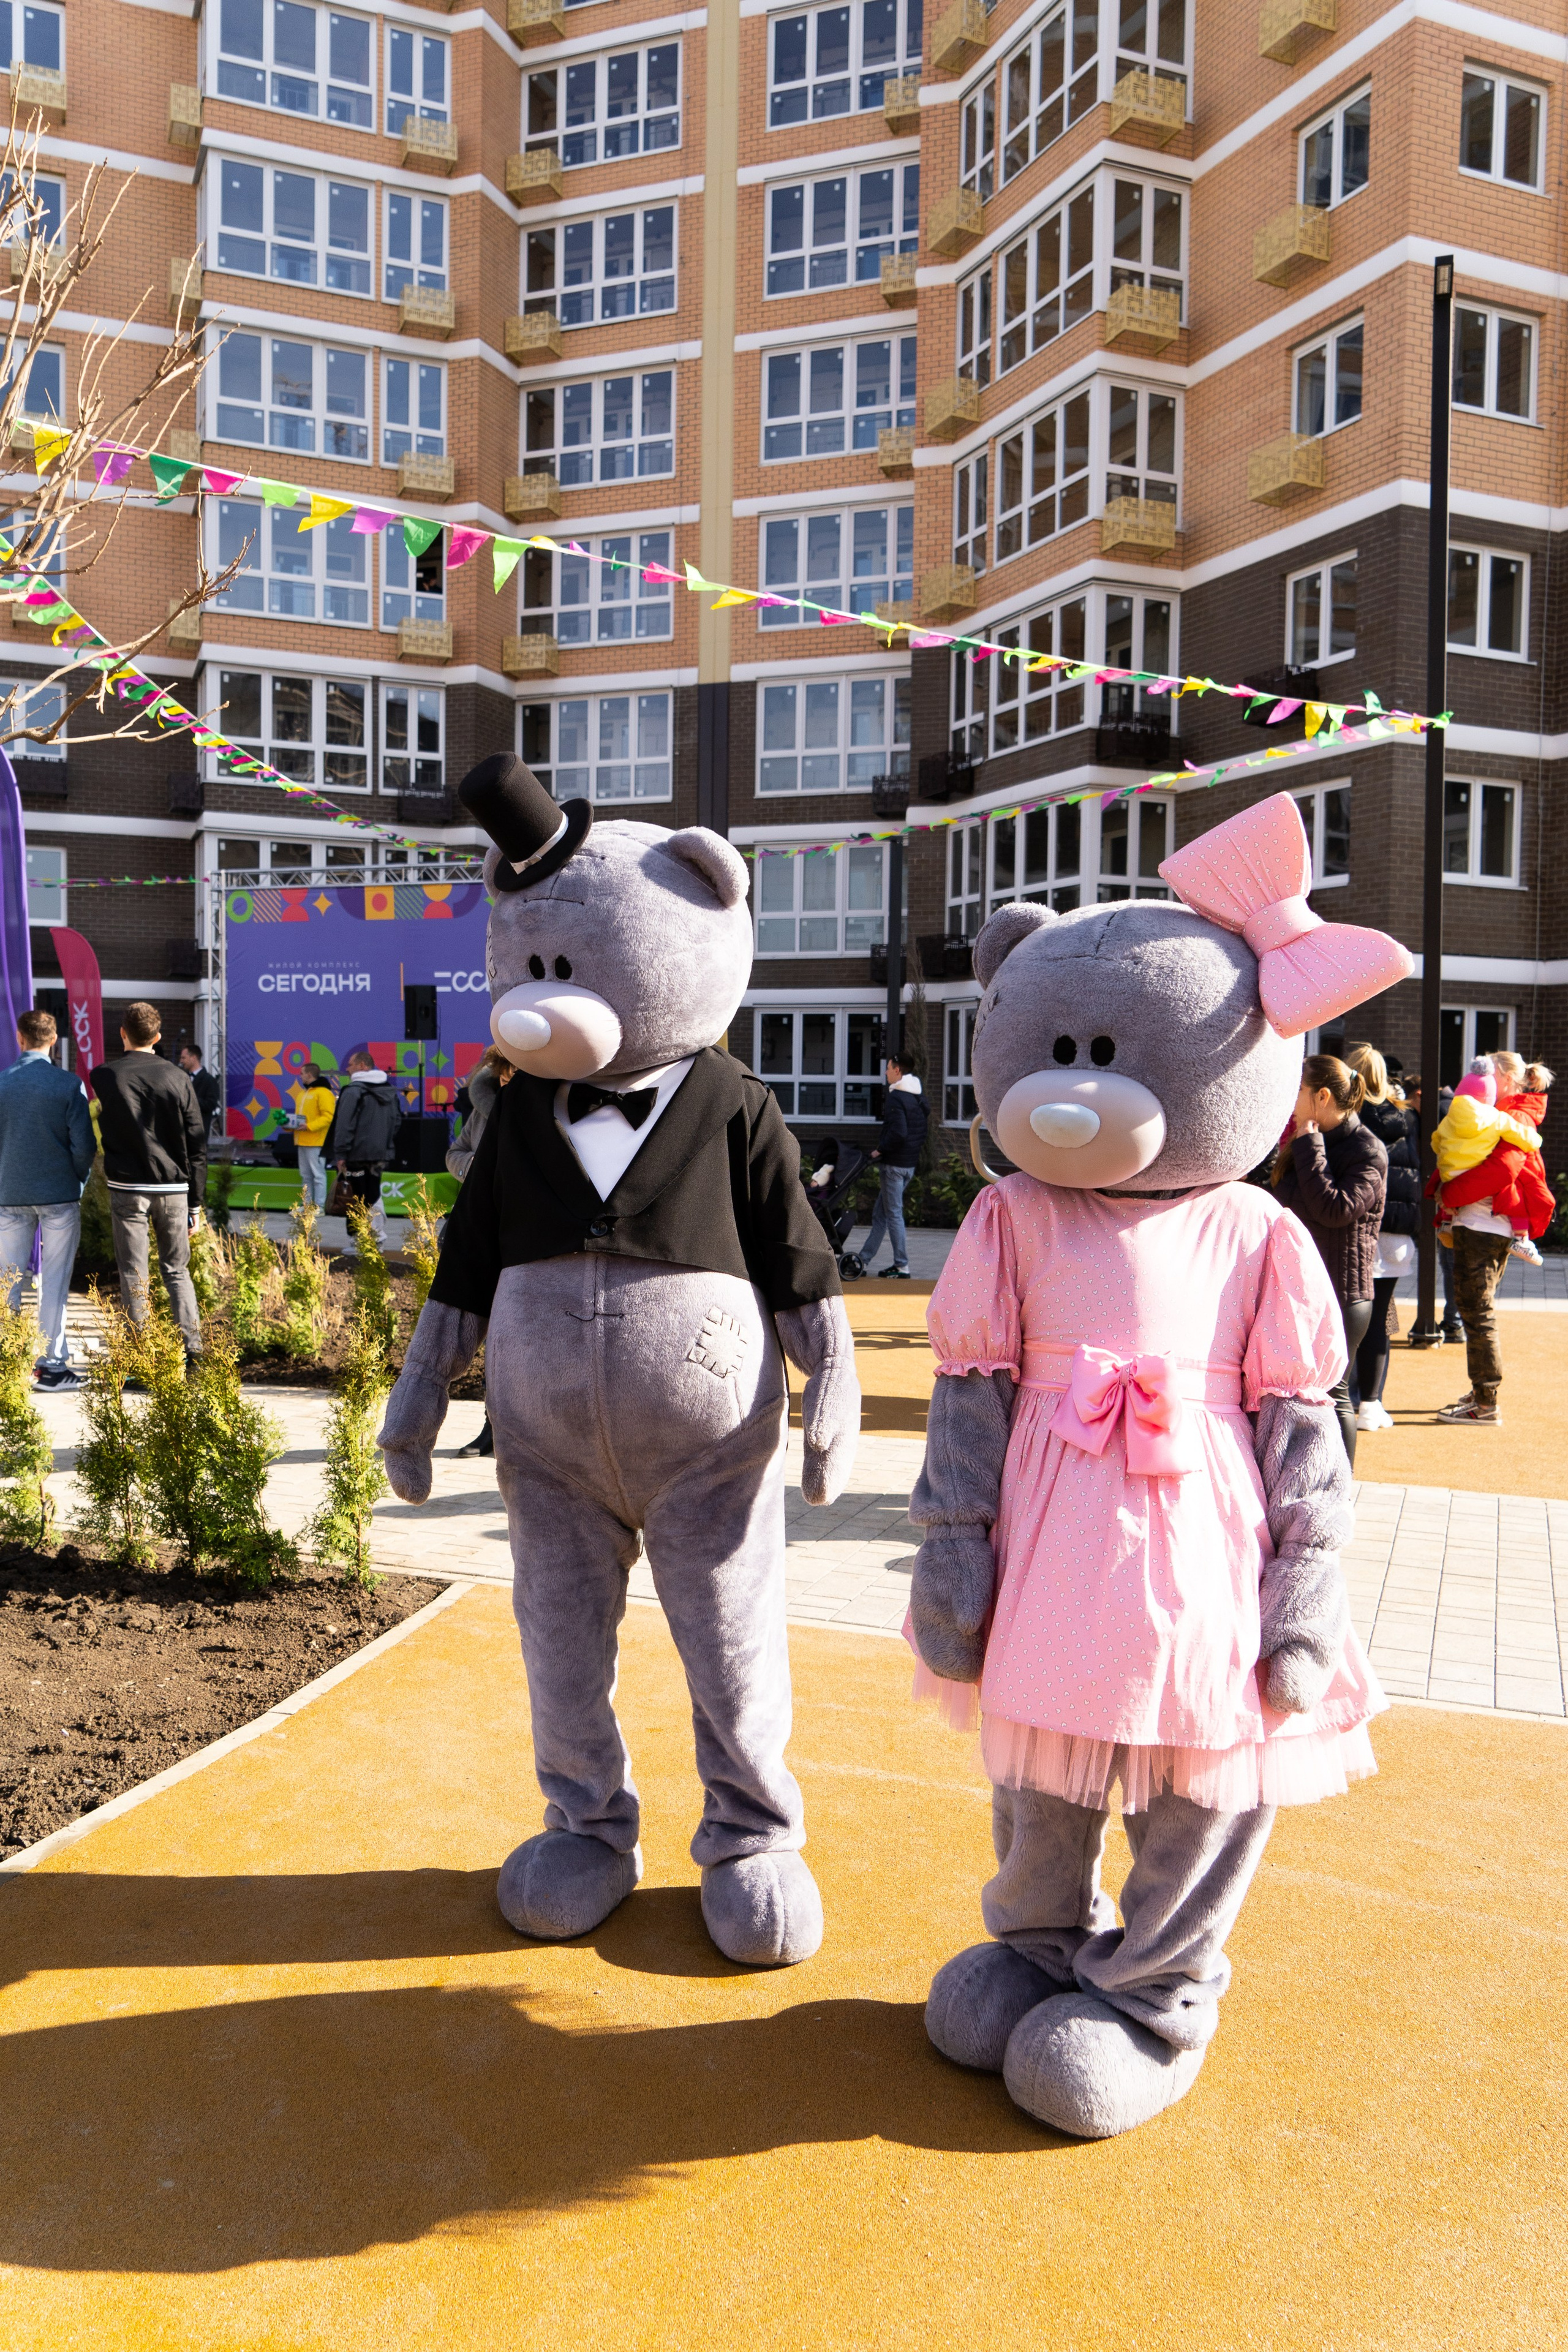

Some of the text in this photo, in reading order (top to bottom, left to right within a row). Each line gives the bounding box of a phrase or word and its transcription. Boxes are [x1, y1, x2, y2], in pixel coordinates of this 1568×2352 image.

[258, 973, 371, 995] СЕГОДНЯ
[452, 971, 490, 992] СС
[380, 1181, 405, 1198] СК
